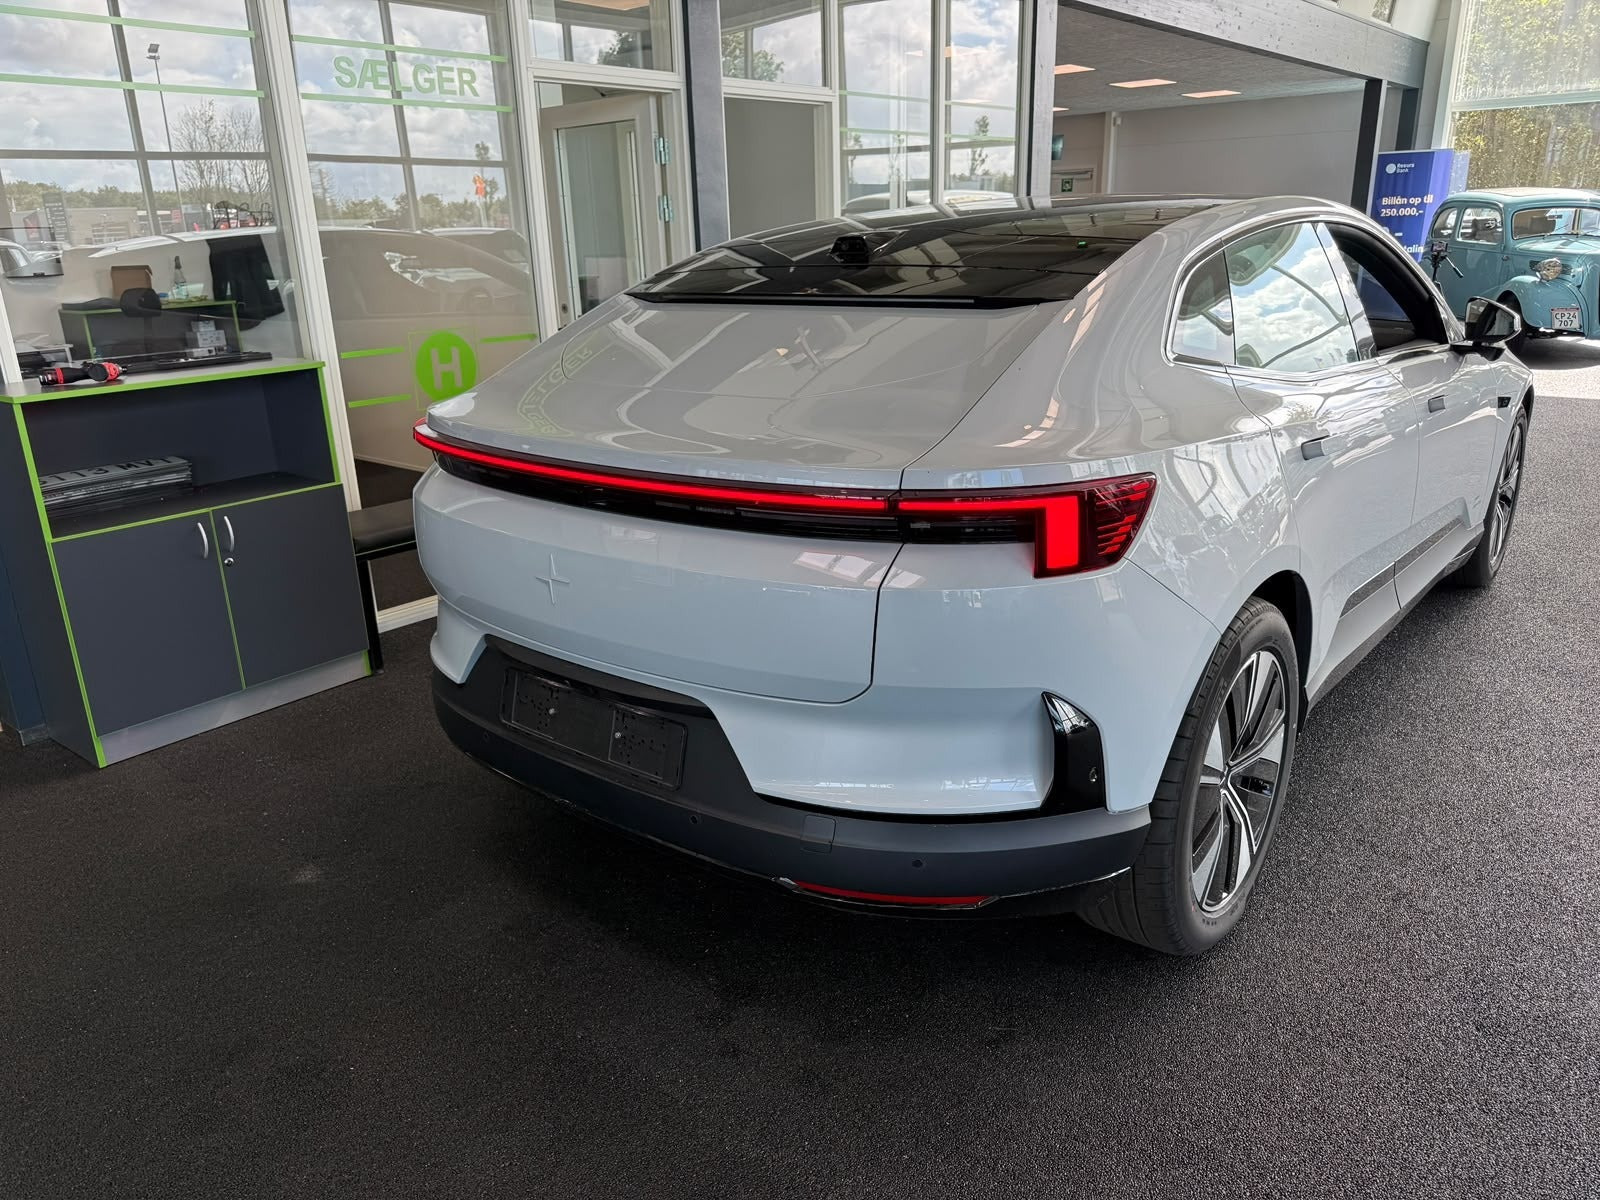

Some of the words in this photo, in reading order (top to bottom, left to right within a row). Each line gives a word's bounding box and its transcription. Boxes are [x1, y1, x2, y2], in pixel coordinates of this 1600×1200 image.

[333, 55, 480, 97] SÆLGER
[1382, 196, 1407, 205] Billån
[1409, 197, 1422, 206] op
[430, 346, 463, 391] H
